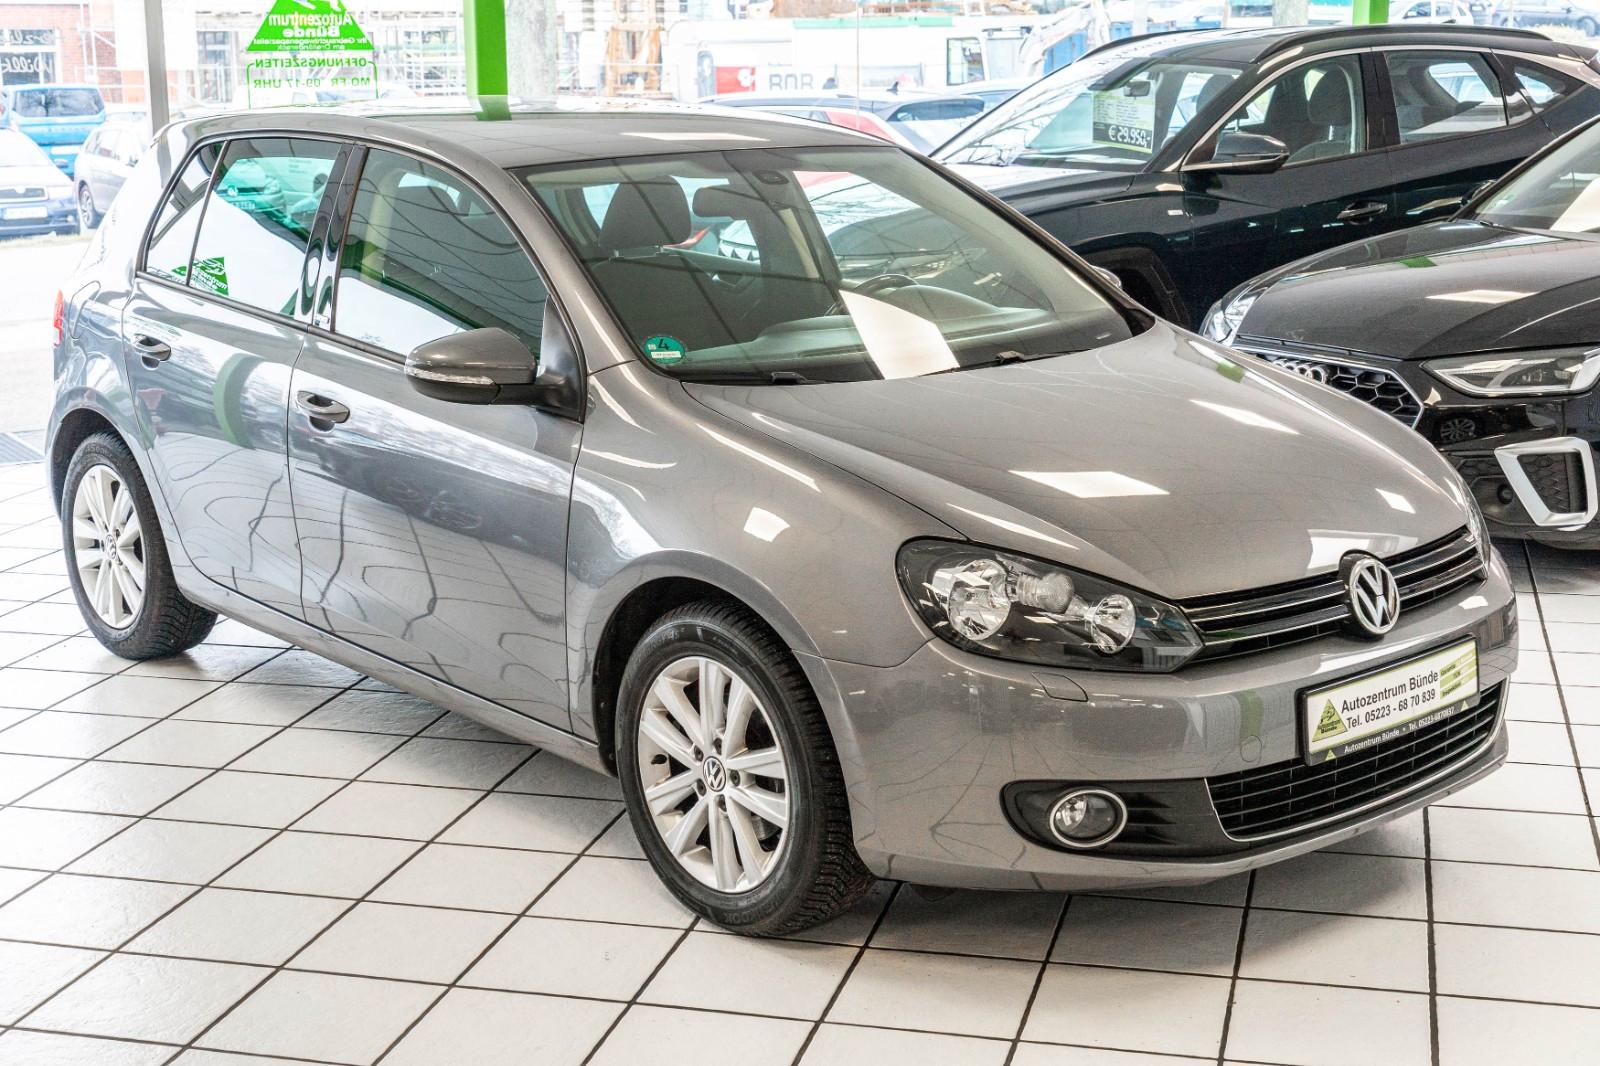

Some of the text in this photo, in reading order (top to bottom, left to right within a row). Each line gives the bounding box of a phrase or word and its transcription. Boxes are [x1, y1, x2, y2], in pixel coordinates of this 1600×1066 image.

[658, 339, 669, 350] 4
[1341, 685, 1407, 714] Autozentrum
[1409, 671, 1439, 691] Bünde
[1346, 716, 1363, 729] Tel.
[1365, 705, 1391, 724] 05223
[1398, 700, 1408, 712] 68
[1410, 695, 1420, 708] 70
[1421, 688, 1436, 704] 839
[1344, 736, 1381, 754] Autozentrum
[1382, 730, 1400, 742] Bünde
